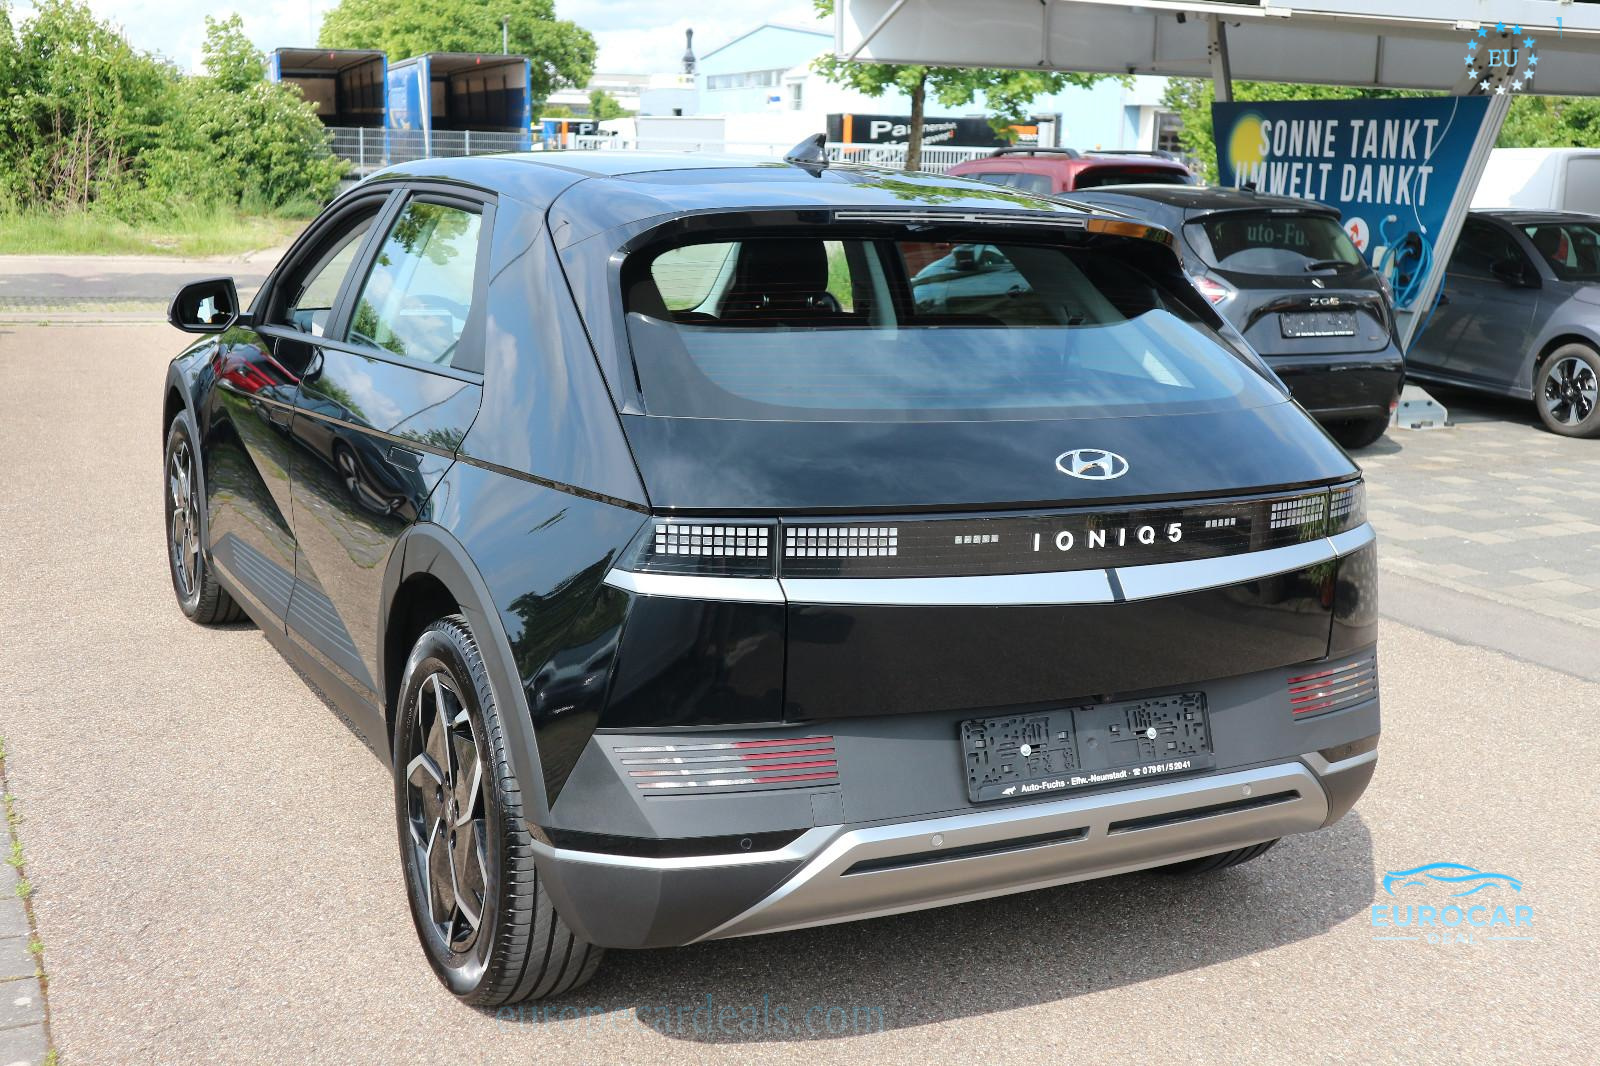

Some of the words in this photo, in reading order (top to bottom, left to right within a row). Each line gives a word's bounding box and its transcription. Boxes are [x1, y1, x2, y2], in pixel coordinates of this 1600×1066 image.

[1258, 119, 1338, 158] SONNE
[1350, 119, 1439, 160] TANKT
[1234, 160, 1333, 201] UMWELT
[1340, 163, 1434, 207] DANKT
[1034, 525, 1155, 551] IONIQ
[1167, 523, 1182, 543] 5
[1021, 779, 1066, 793] Auto-Fuchs
